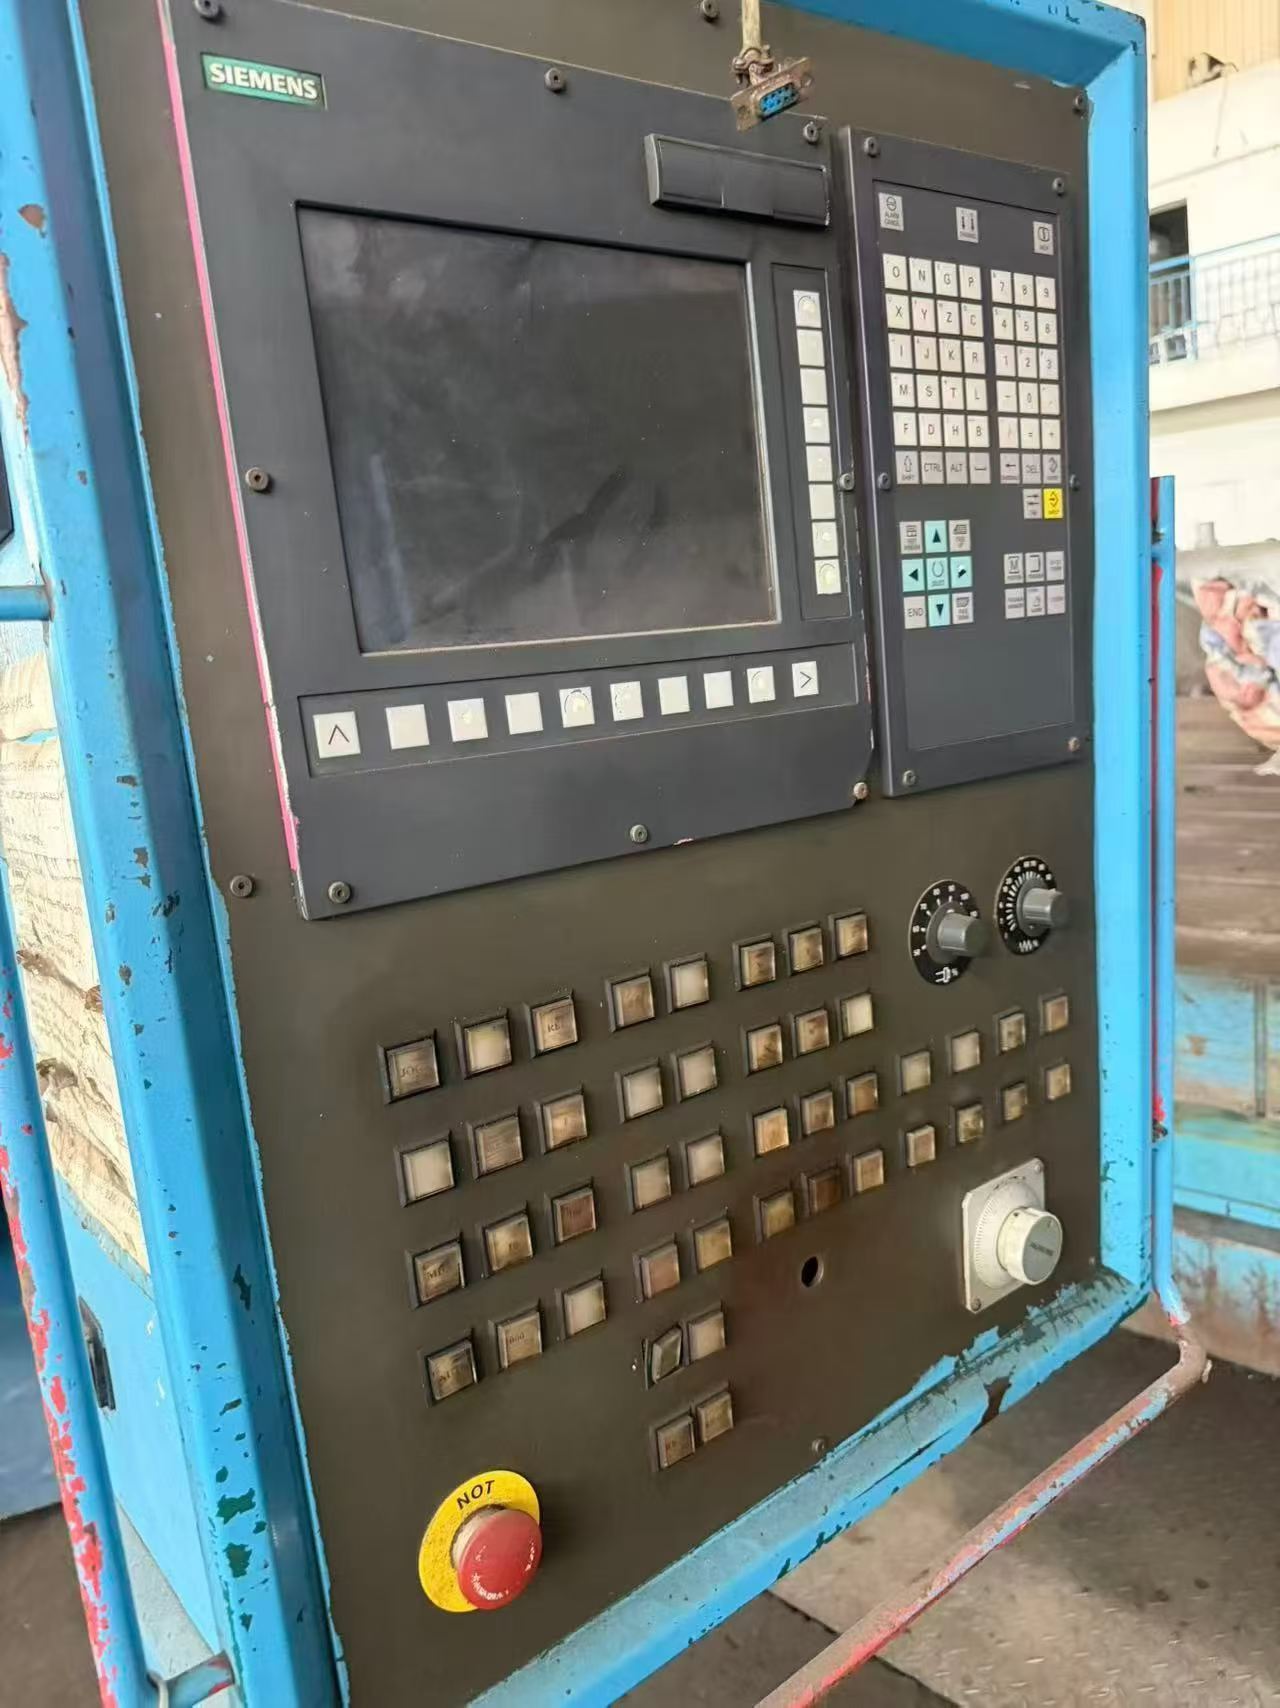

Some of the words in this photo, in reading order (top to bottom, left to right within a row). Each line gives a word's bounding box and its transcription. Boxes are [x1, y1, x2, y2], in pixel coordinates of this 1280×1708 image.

[209, 62, 318, 100] SIEMENS
[919, 270, 926, 281] N
[943, 273, 951, 285] G
[968, 276, 974, 287] P
[1000, 281, 1004, 292] 7
[896, 305, 903, 318] X
[921, 308, 928, 320] Y
[946, 312, 953, 323] Z
[1002, 319, 1007, 329] 4
[1024, 321, 1029, 332] 5
[924, 348, 930, 359] J
[948, 350, 956, 360] K
[972, 352, 978, 362] R
[1025, 357, 1031, 368] 2
[899, 384, 909, 396] M
[925, 386, 933, 397] S
[950, 387, 957, 400] T
[903, 423, 909, 434] F
[927, 424, 935, 435] D
[951, 426, 959, 436] H
[923, 462, 943, 473] CTRL
[950, 463, 963, 473] ALT
[907, 608, 924, 618] END
[456, 1480, 496, 1510] NOT
